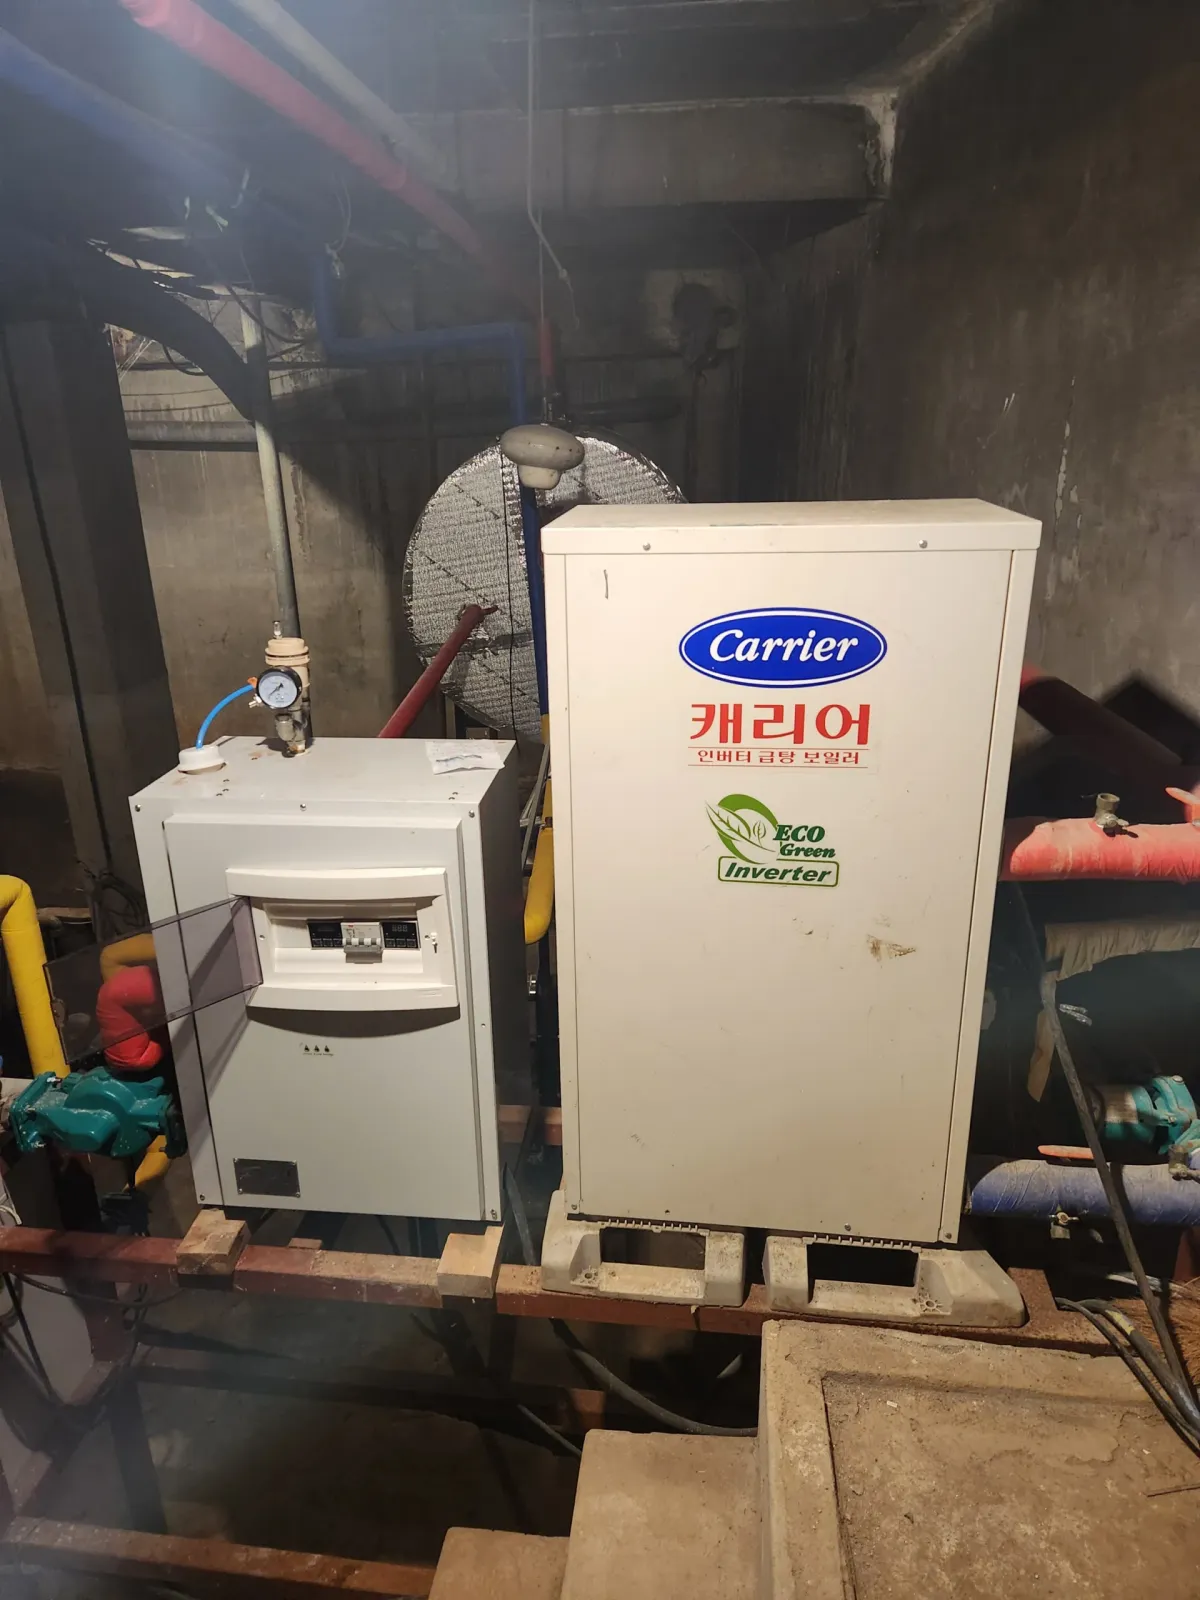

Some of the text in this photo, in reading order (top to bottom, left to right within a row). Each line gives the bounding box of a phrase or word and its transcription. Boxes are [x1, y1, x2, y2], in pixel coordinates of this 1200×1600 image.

[709, 629, 859, 662] Carrier
[690, 703, 870, 745] 캐리어
[697, 750, 859, 764] 인버터 급탕 보일러
[773, 824, 825, 841] ECO
[779, 843, 836, 858] Green
[725, 862, 832, 883] Inverter
